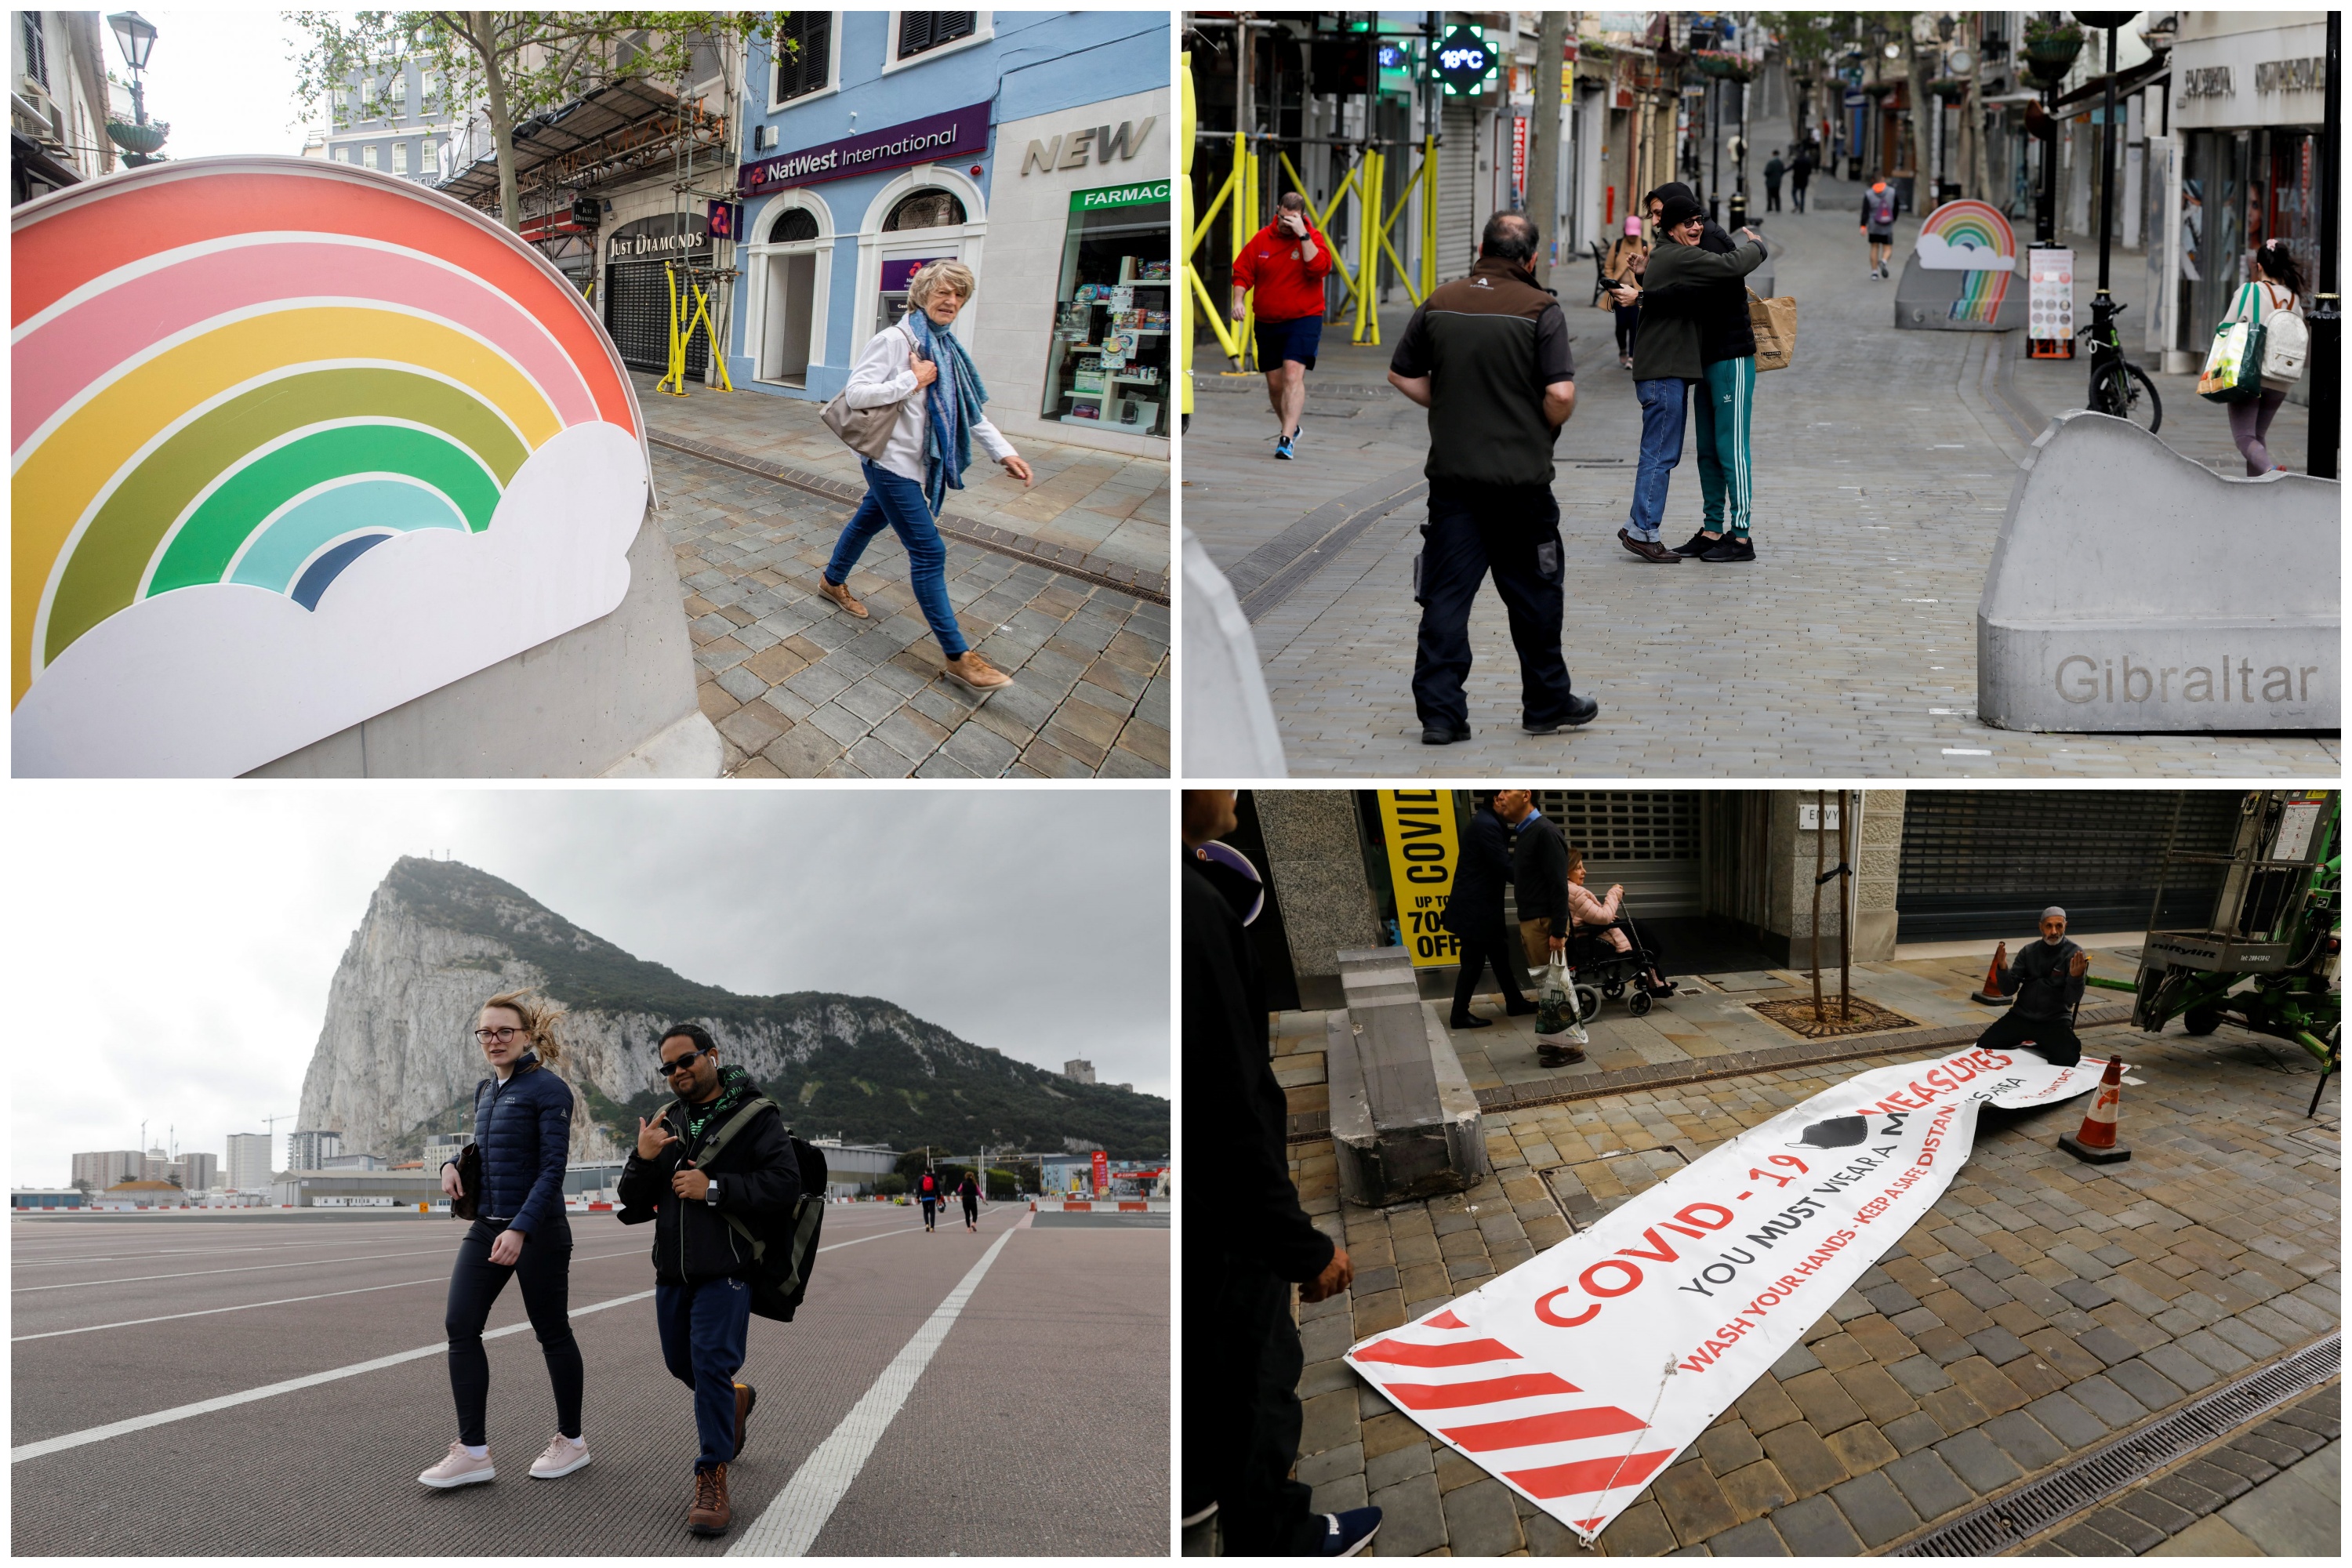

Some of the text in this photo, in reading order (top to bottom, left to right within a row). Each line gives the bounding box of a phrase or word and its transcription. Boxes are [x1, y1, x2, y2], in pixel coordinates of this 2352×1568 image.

[768, 124, 956, 182] NatWest International
[1022, 116, 1156, 175] NEW
[1084, 184, 1171, 206] FARMAC
[575, 215, 599, 223] DIAMONDS
[611, 231, 702, 258] JUST DIAMONDS
[2055, 655, 2318, 703] Gibraltar
[1415, 896, 1432, 908] UP
[1417, 935, 1461, 958] OFF
[2151, 942, 2216, 959] niftylift
[1534, 1203, 1734, 1327] COVID
[1749, 1155, 1809, 1188] 19
[1855, 1048, 2013, 1115] MEASURES
[1678, 1247, 1755, 1297] YOU
[1745, 1196, 1826, 1249] MUST
[1813, 1157, 1884, 1192] WEAR
[1871, 1145, 1898, 1158] A
[1678, 1317, 1755, 1373] WASH
[1741, 1275, 1806, 1316] YOUR
[1793, 1229, 1857, 1276] HANDS
[1853, 1196, 1899, 1225] KEEP
[1893, 1167, 1929, 1189] SAFE
[1917, 1102, 1960, 1167] DISTAN
